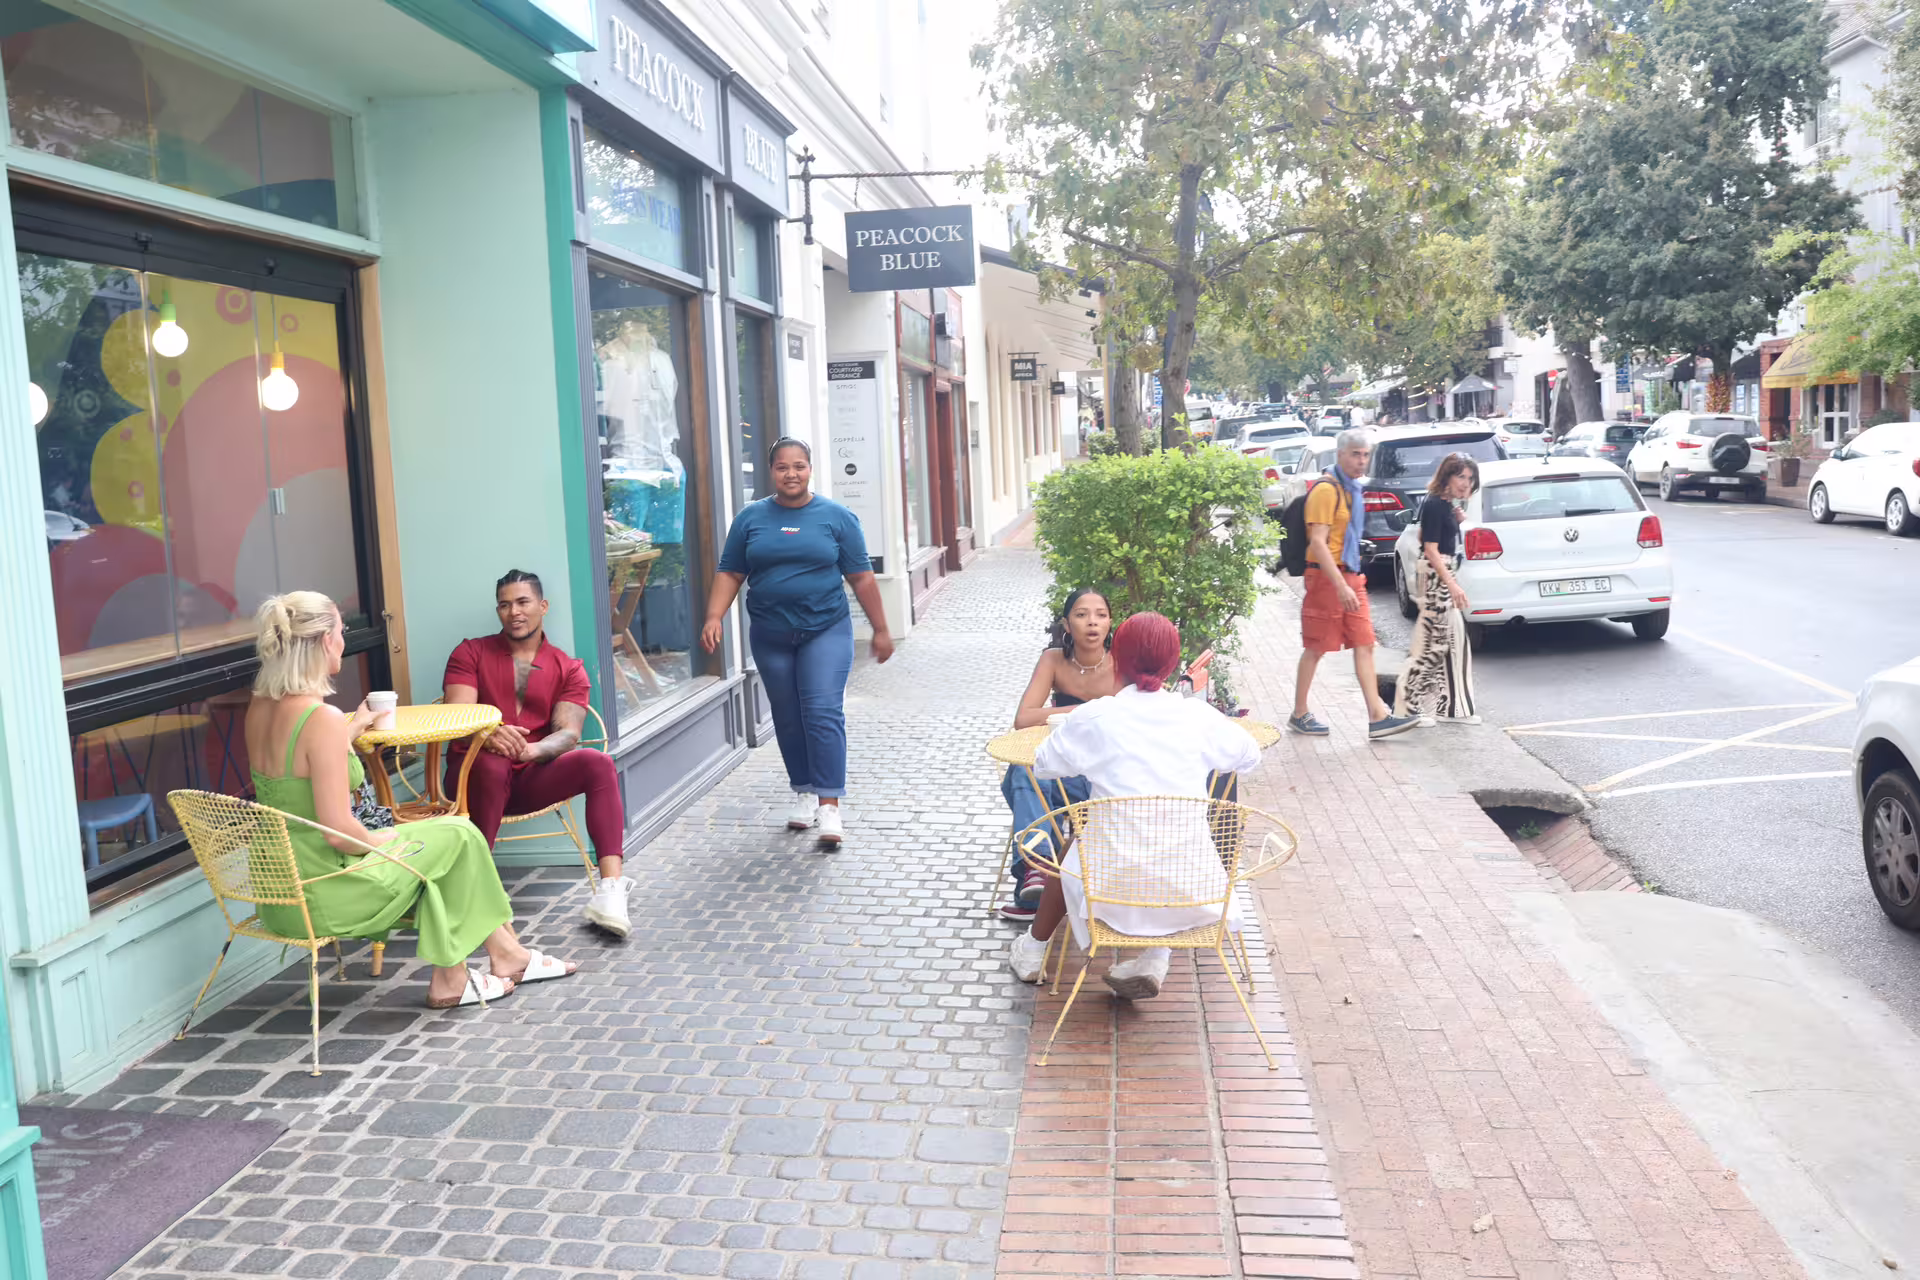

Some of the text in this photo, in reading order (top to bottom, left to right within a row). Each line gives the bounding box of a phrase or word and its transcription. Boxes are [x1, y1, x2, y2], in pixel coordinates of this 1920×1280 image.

[609, 14, 778, 184] PEACOCK BLUE
[855, 224, 964, 248] PEACOCK
[880, 251, 941, 272] BLUE
[829, 366, 863, 374] COURTYARD
[831, 372, 861, 380] ENTRANCE
[1569, 580, 1587, 592] 353
[1594, 580, 1607, 590] EC
